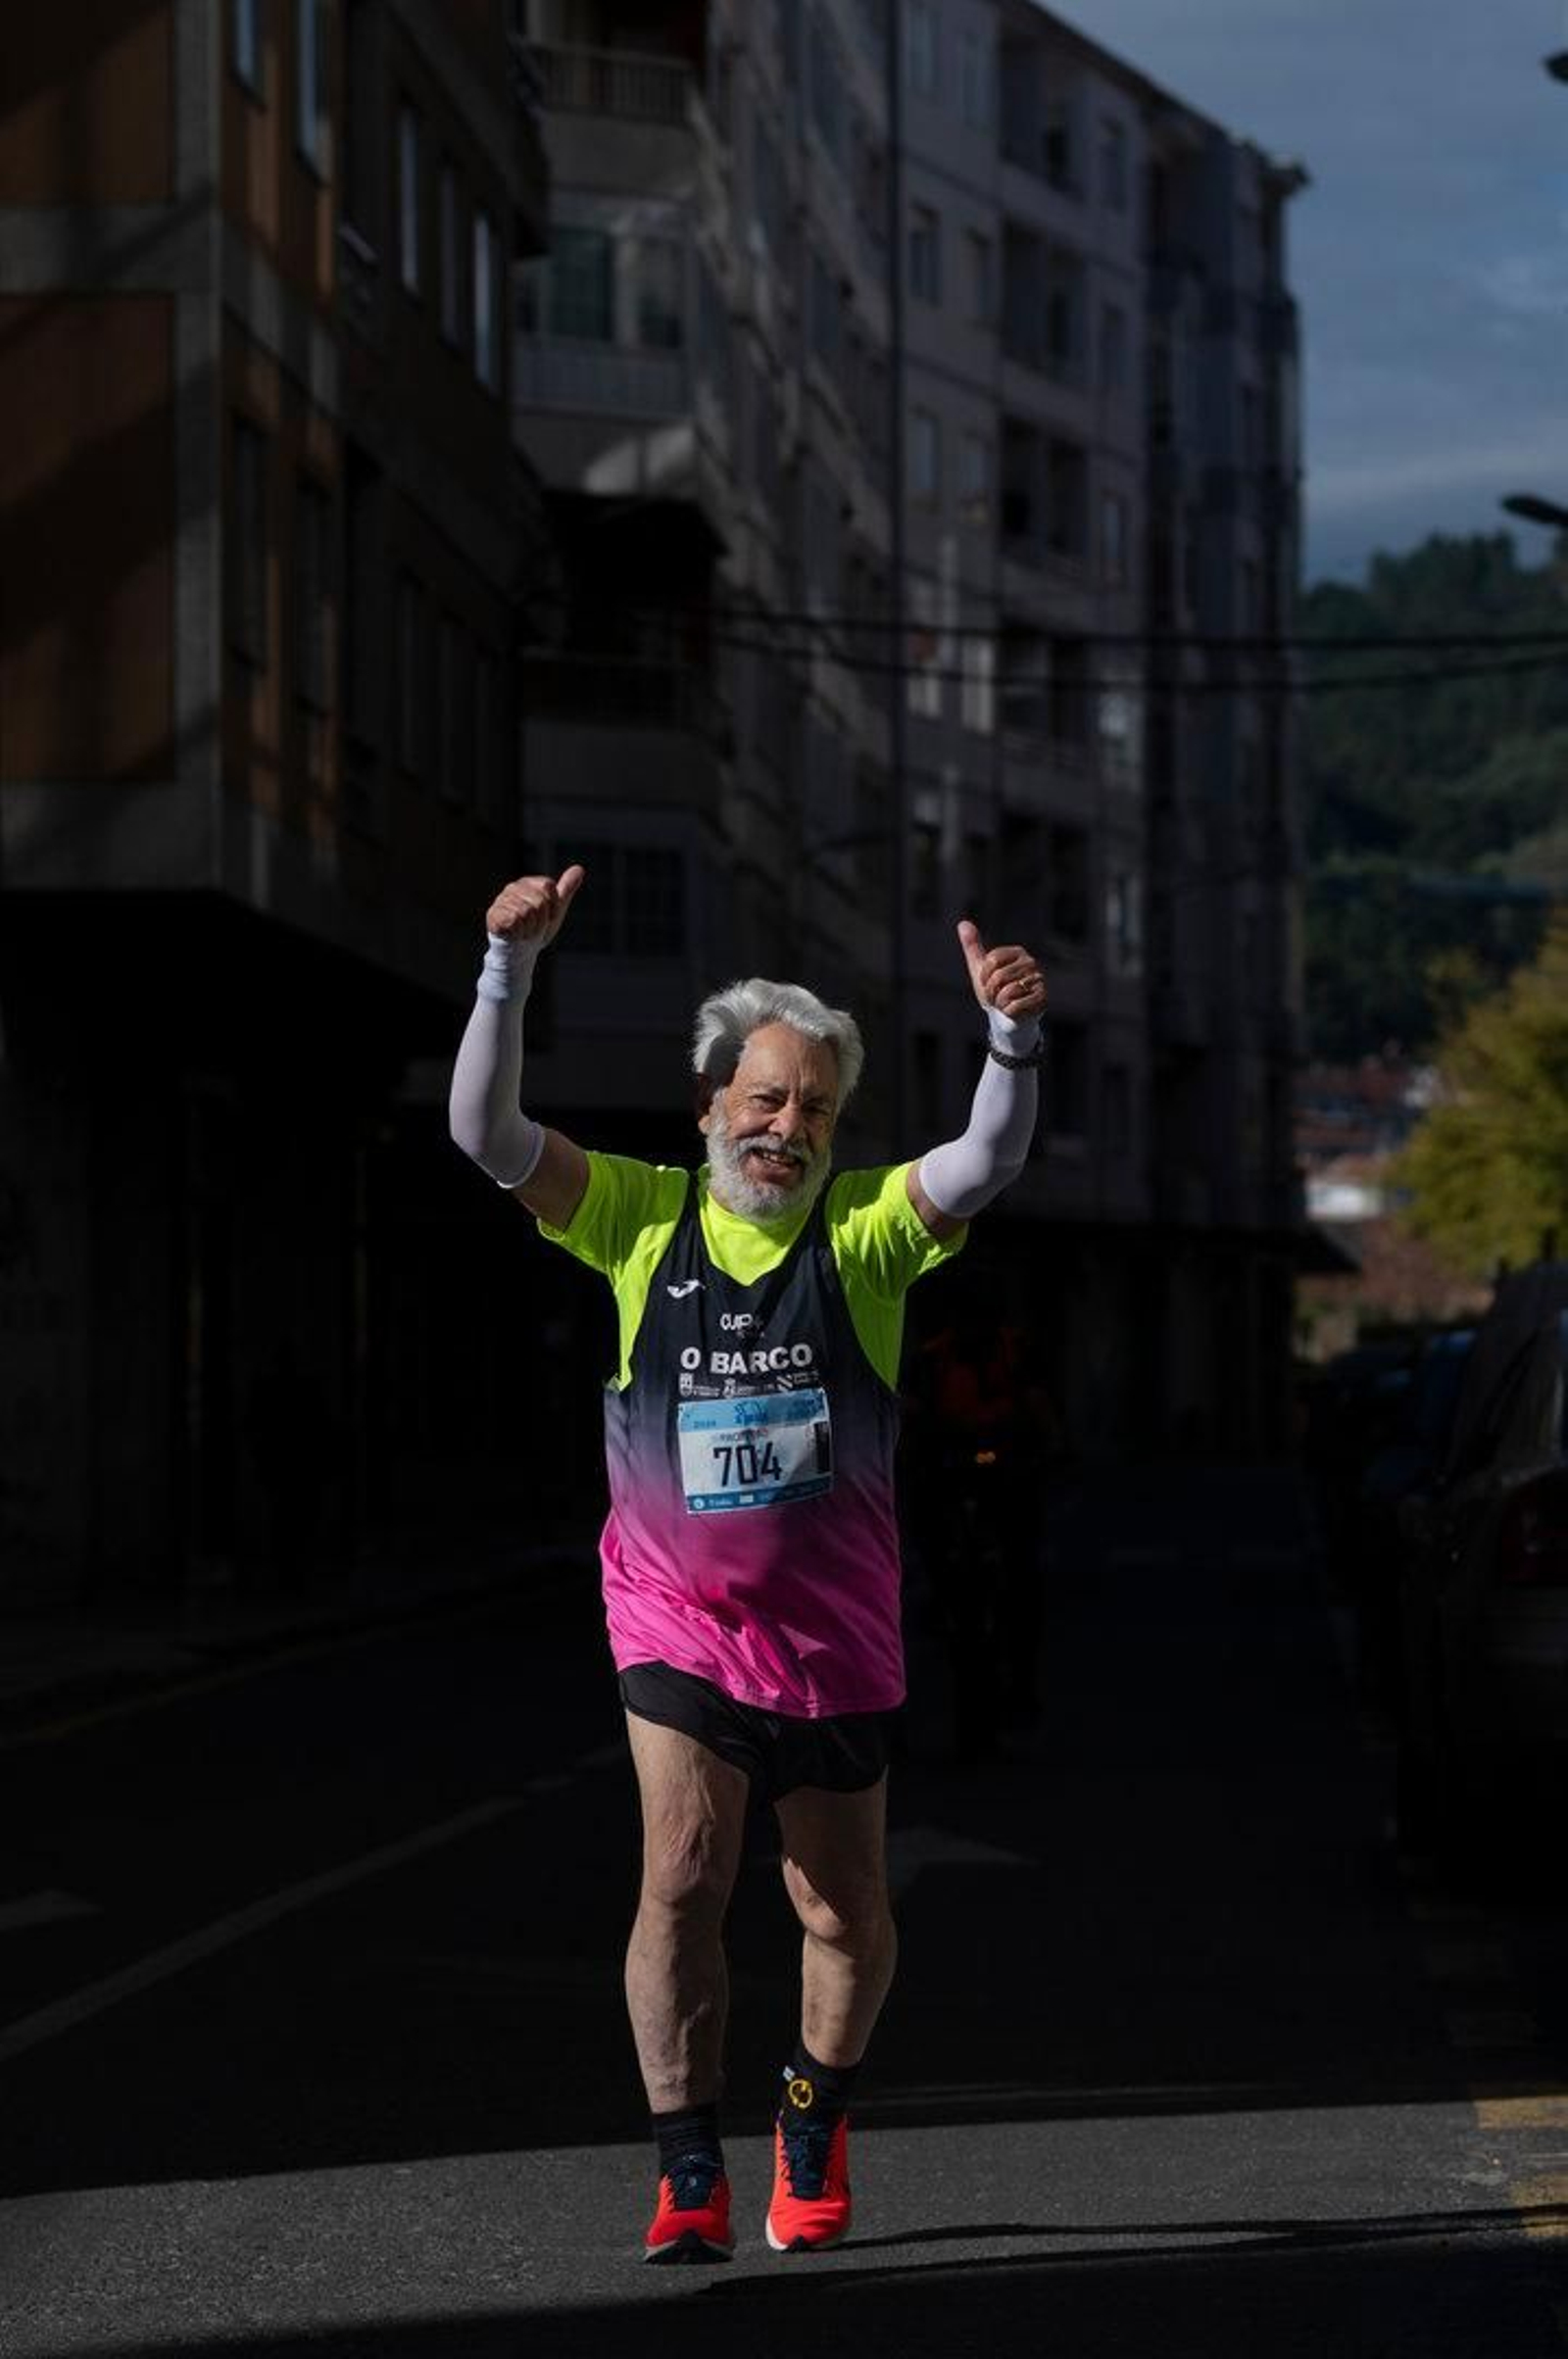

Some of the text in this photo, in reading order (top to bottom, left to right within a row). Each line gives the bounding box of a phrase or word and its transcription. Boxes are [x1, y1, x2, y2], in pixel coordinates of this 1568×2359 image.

[680, 1343, 812, 1374] O BARCO
[712, 1443, 782, 1487] 704
